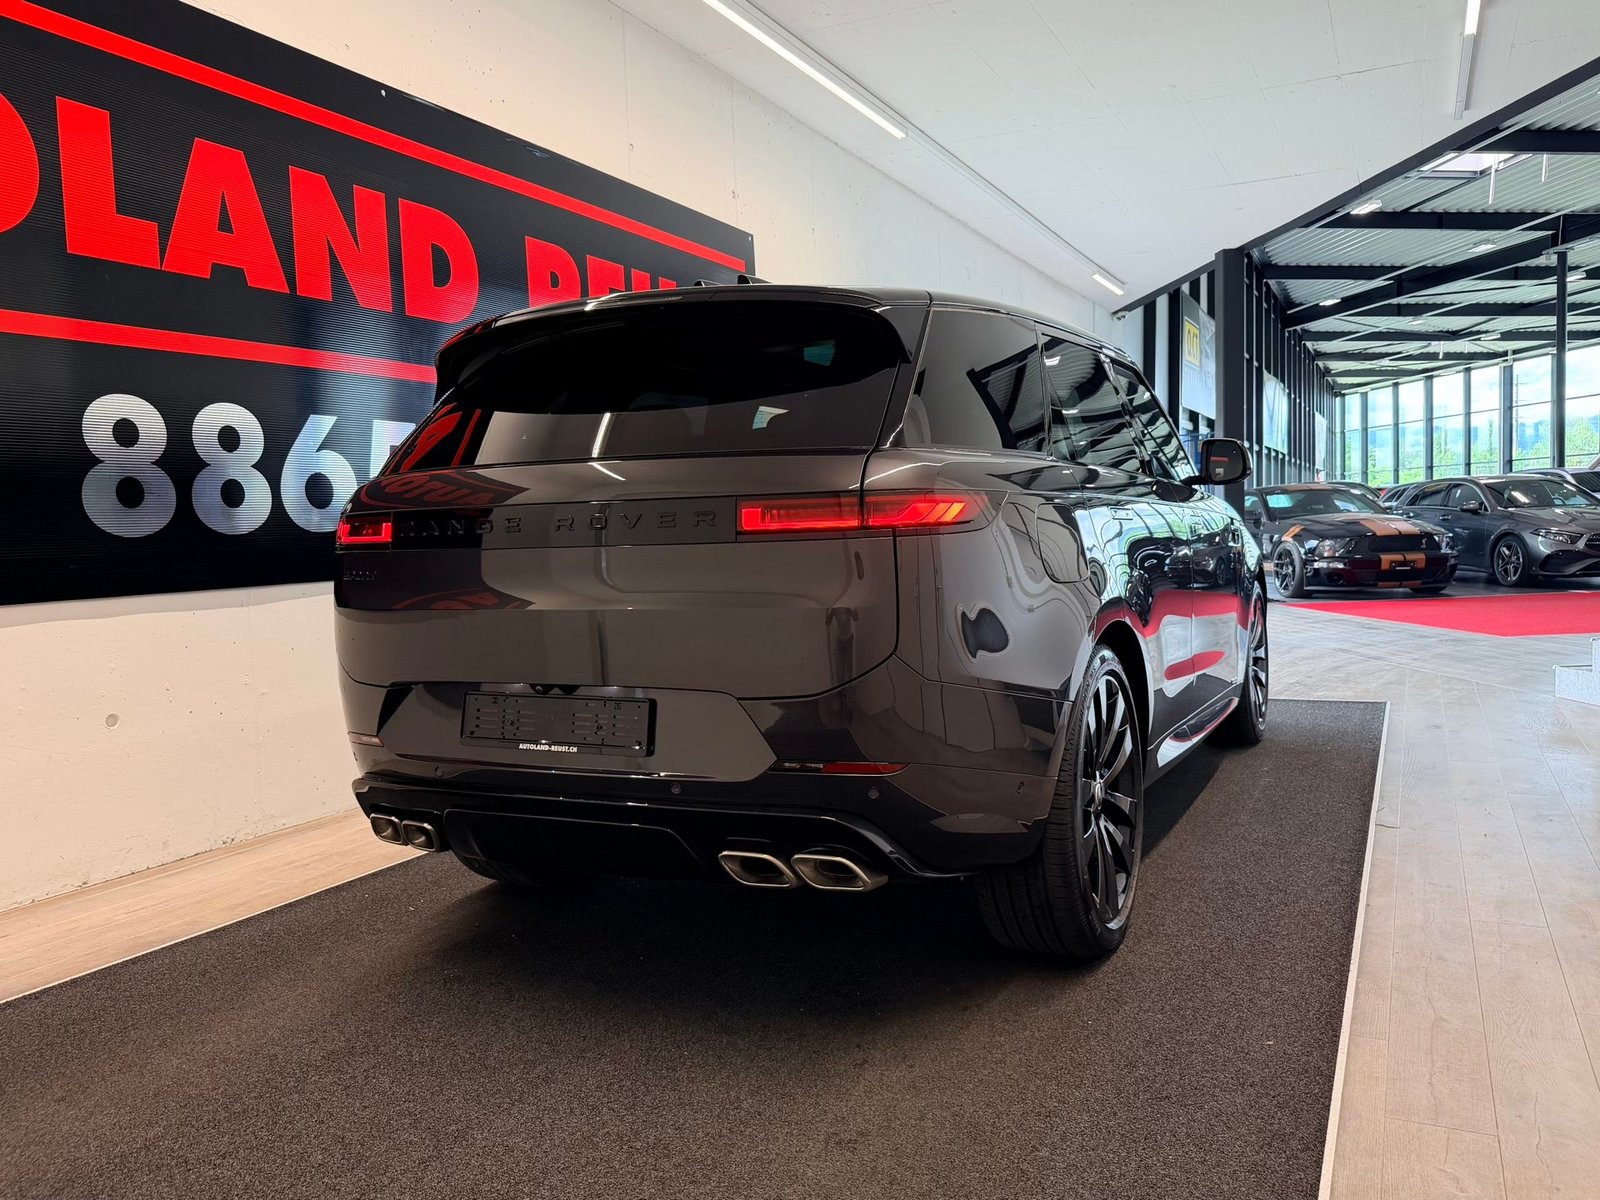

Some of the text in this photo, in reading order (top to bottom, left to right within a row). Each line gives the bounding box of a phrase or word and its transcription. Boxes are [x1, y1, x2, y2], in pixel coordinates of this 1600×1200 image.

[400, 510, 717, 537] RANGE ROVER
[518, 743, 578, 753] AUTOLAND-REUST.CH
